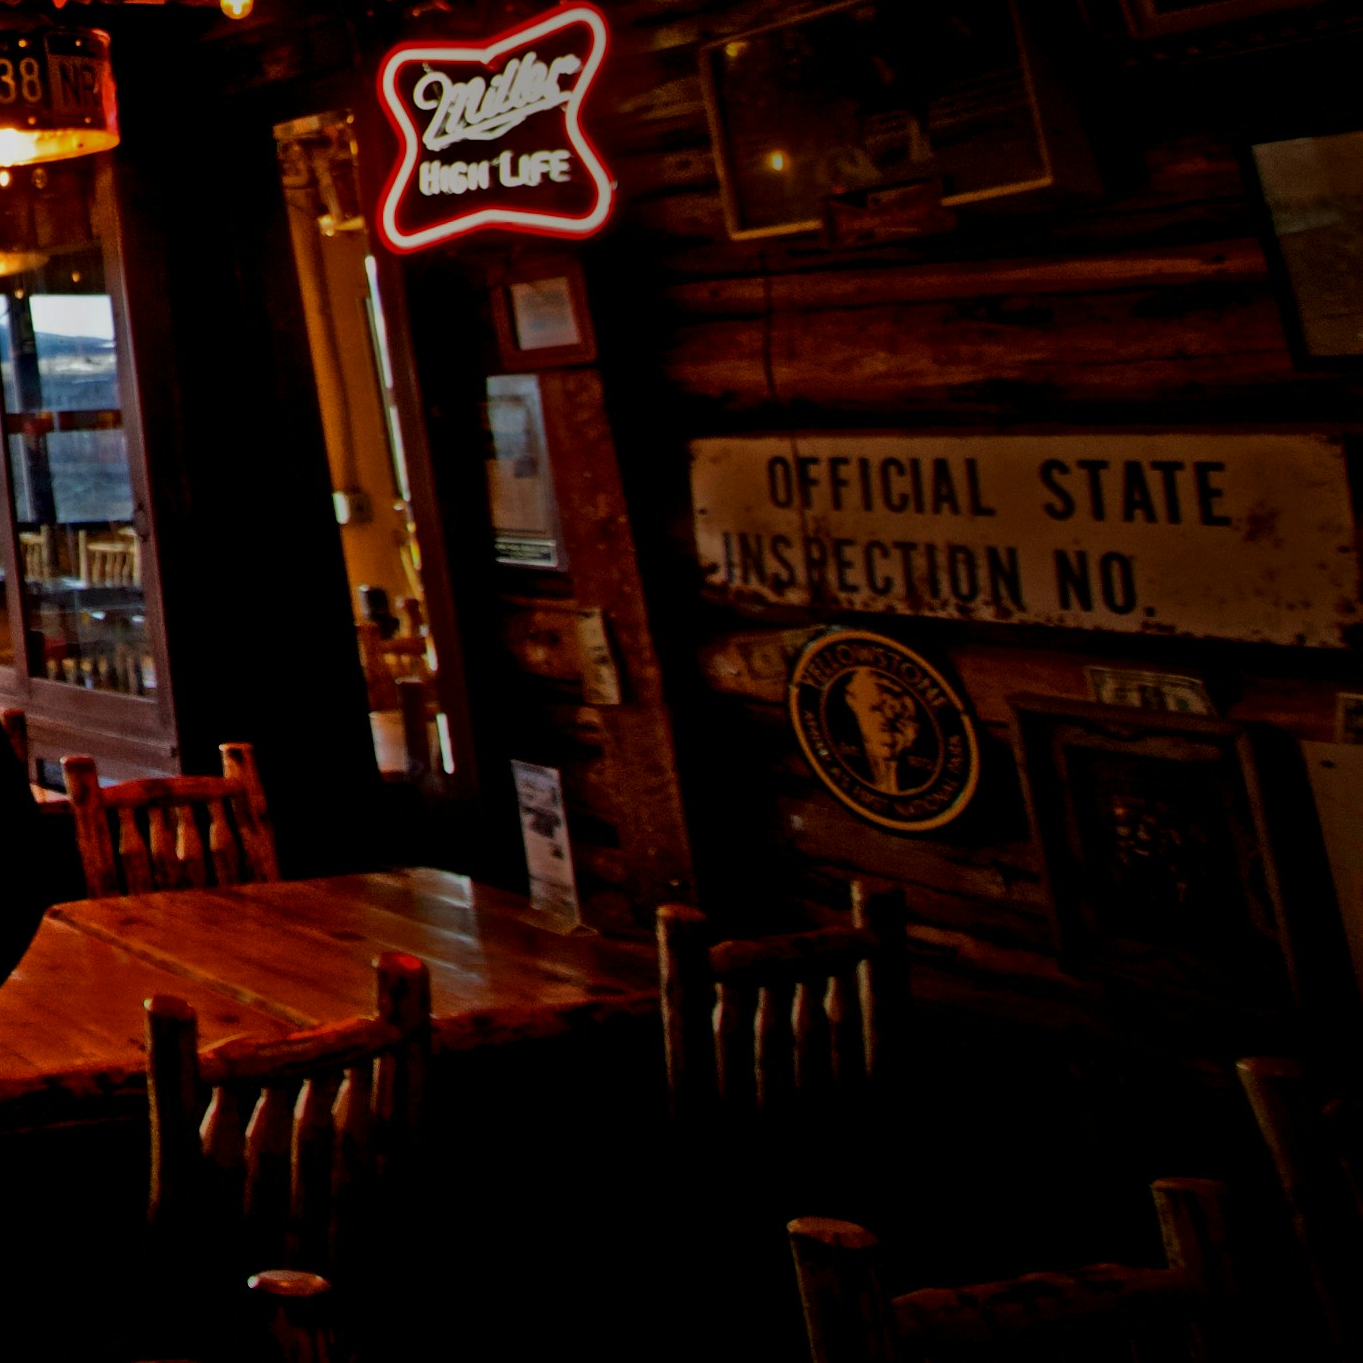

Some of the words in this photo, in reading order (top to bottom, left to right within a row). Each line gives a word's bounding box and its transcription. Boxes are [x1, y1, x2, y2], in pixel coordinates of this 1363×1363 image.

[412, 50, 583, 152] Miller
[767, 454, 997, 519] OFFICIAL
[1039, 456, 1233, 529] STATE
[722, 529, 1025, 611] INSPECTION
[1054, 548, 1157, 619] NO.
[801, 643, 950, 710] YELLOWSTONE
